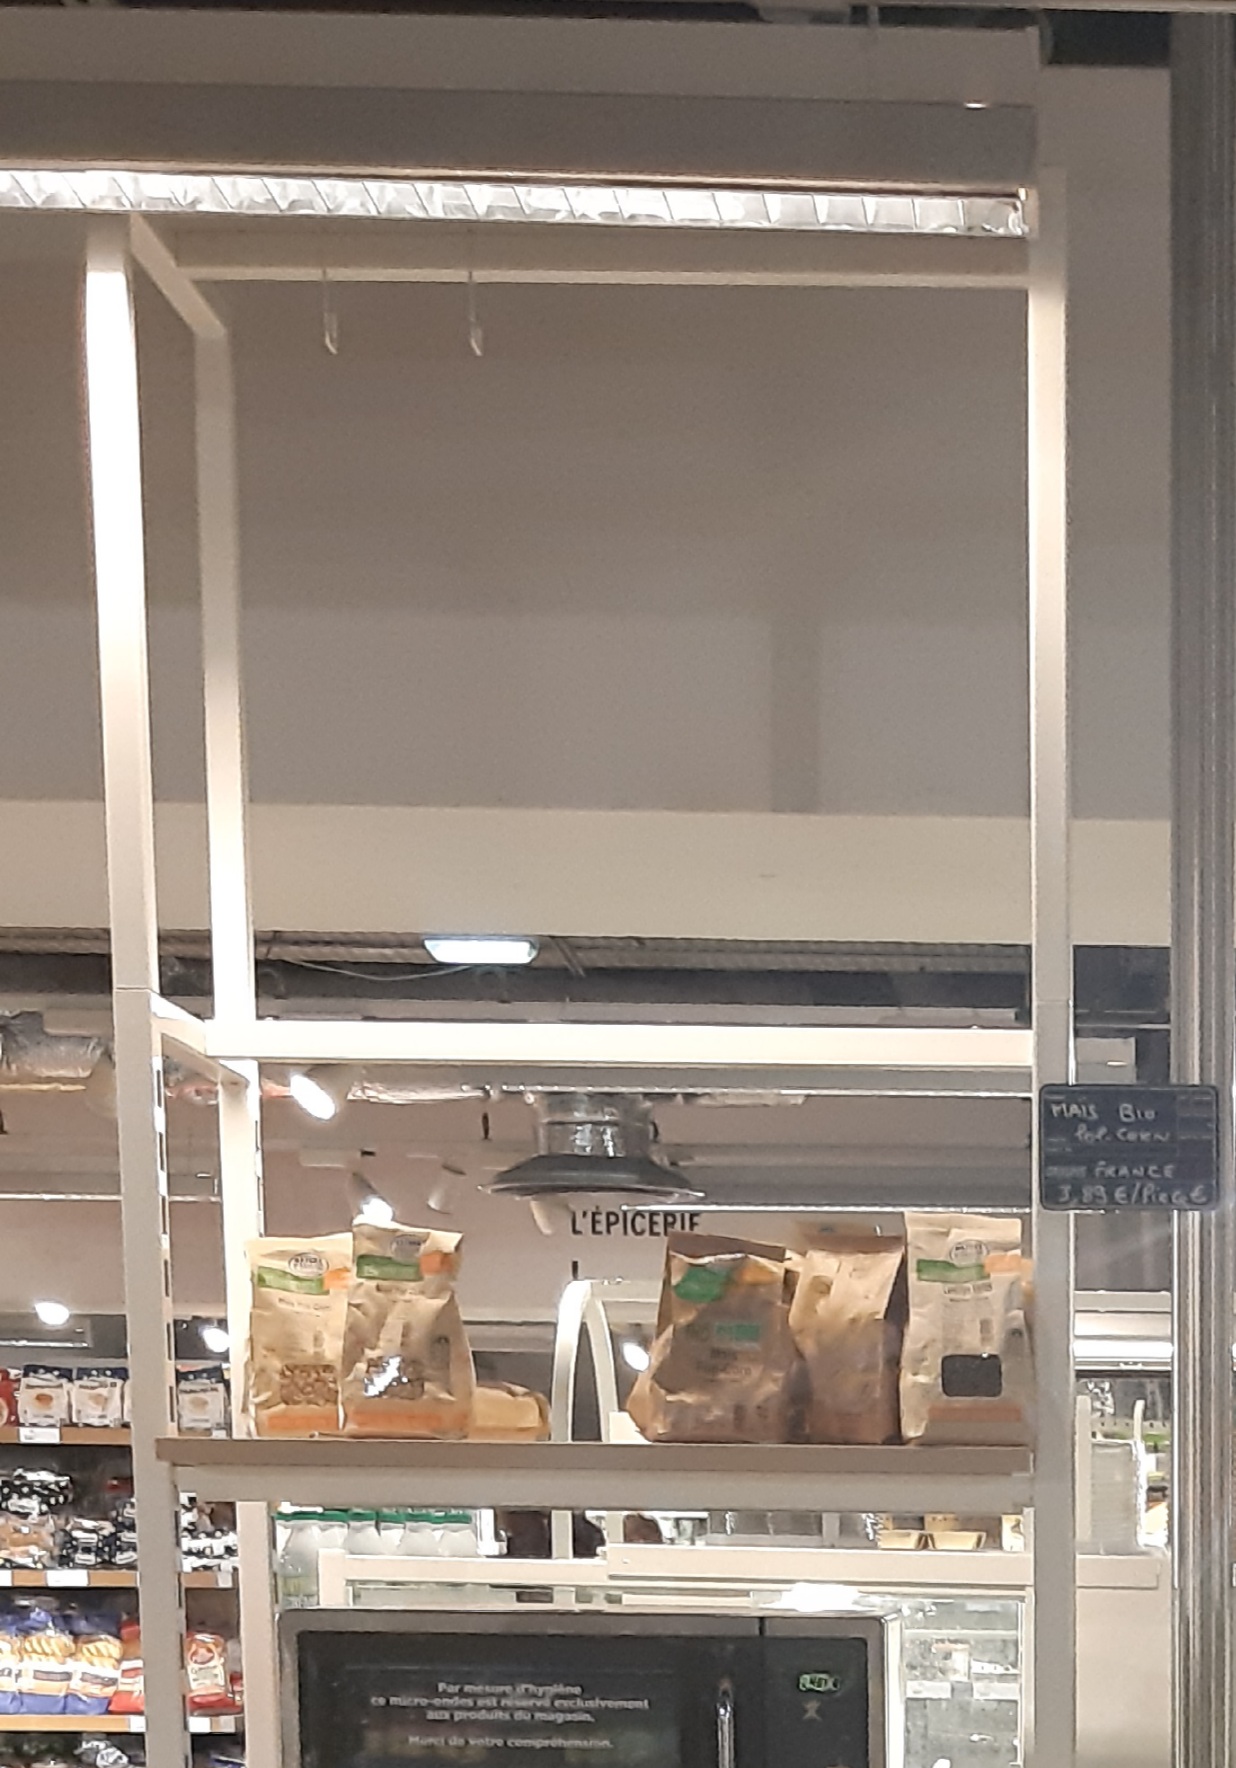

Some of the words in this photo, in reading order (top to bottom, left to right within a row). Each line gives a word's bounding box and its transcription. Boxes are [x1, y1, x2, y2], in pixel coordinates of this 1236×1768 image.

[1095, 1161, 1174, 1178] FRANCE
[437, 1682, 460, 1693] Par
[463, 1684, 513, 1694] mesure
[389, 1696, 474, 1707] micro-ondes
[476, 1698, 498, 1708] est
[553, 1697, 649, 1709] exclusivement
[453, 1709, 510, 1722] produits
[513, 1710, 531, 1720] du
[408, 1736, 445, 1746] Merci
[448, 1736, 465, 1746] de
[467, 1737, 504, 1747] votre
